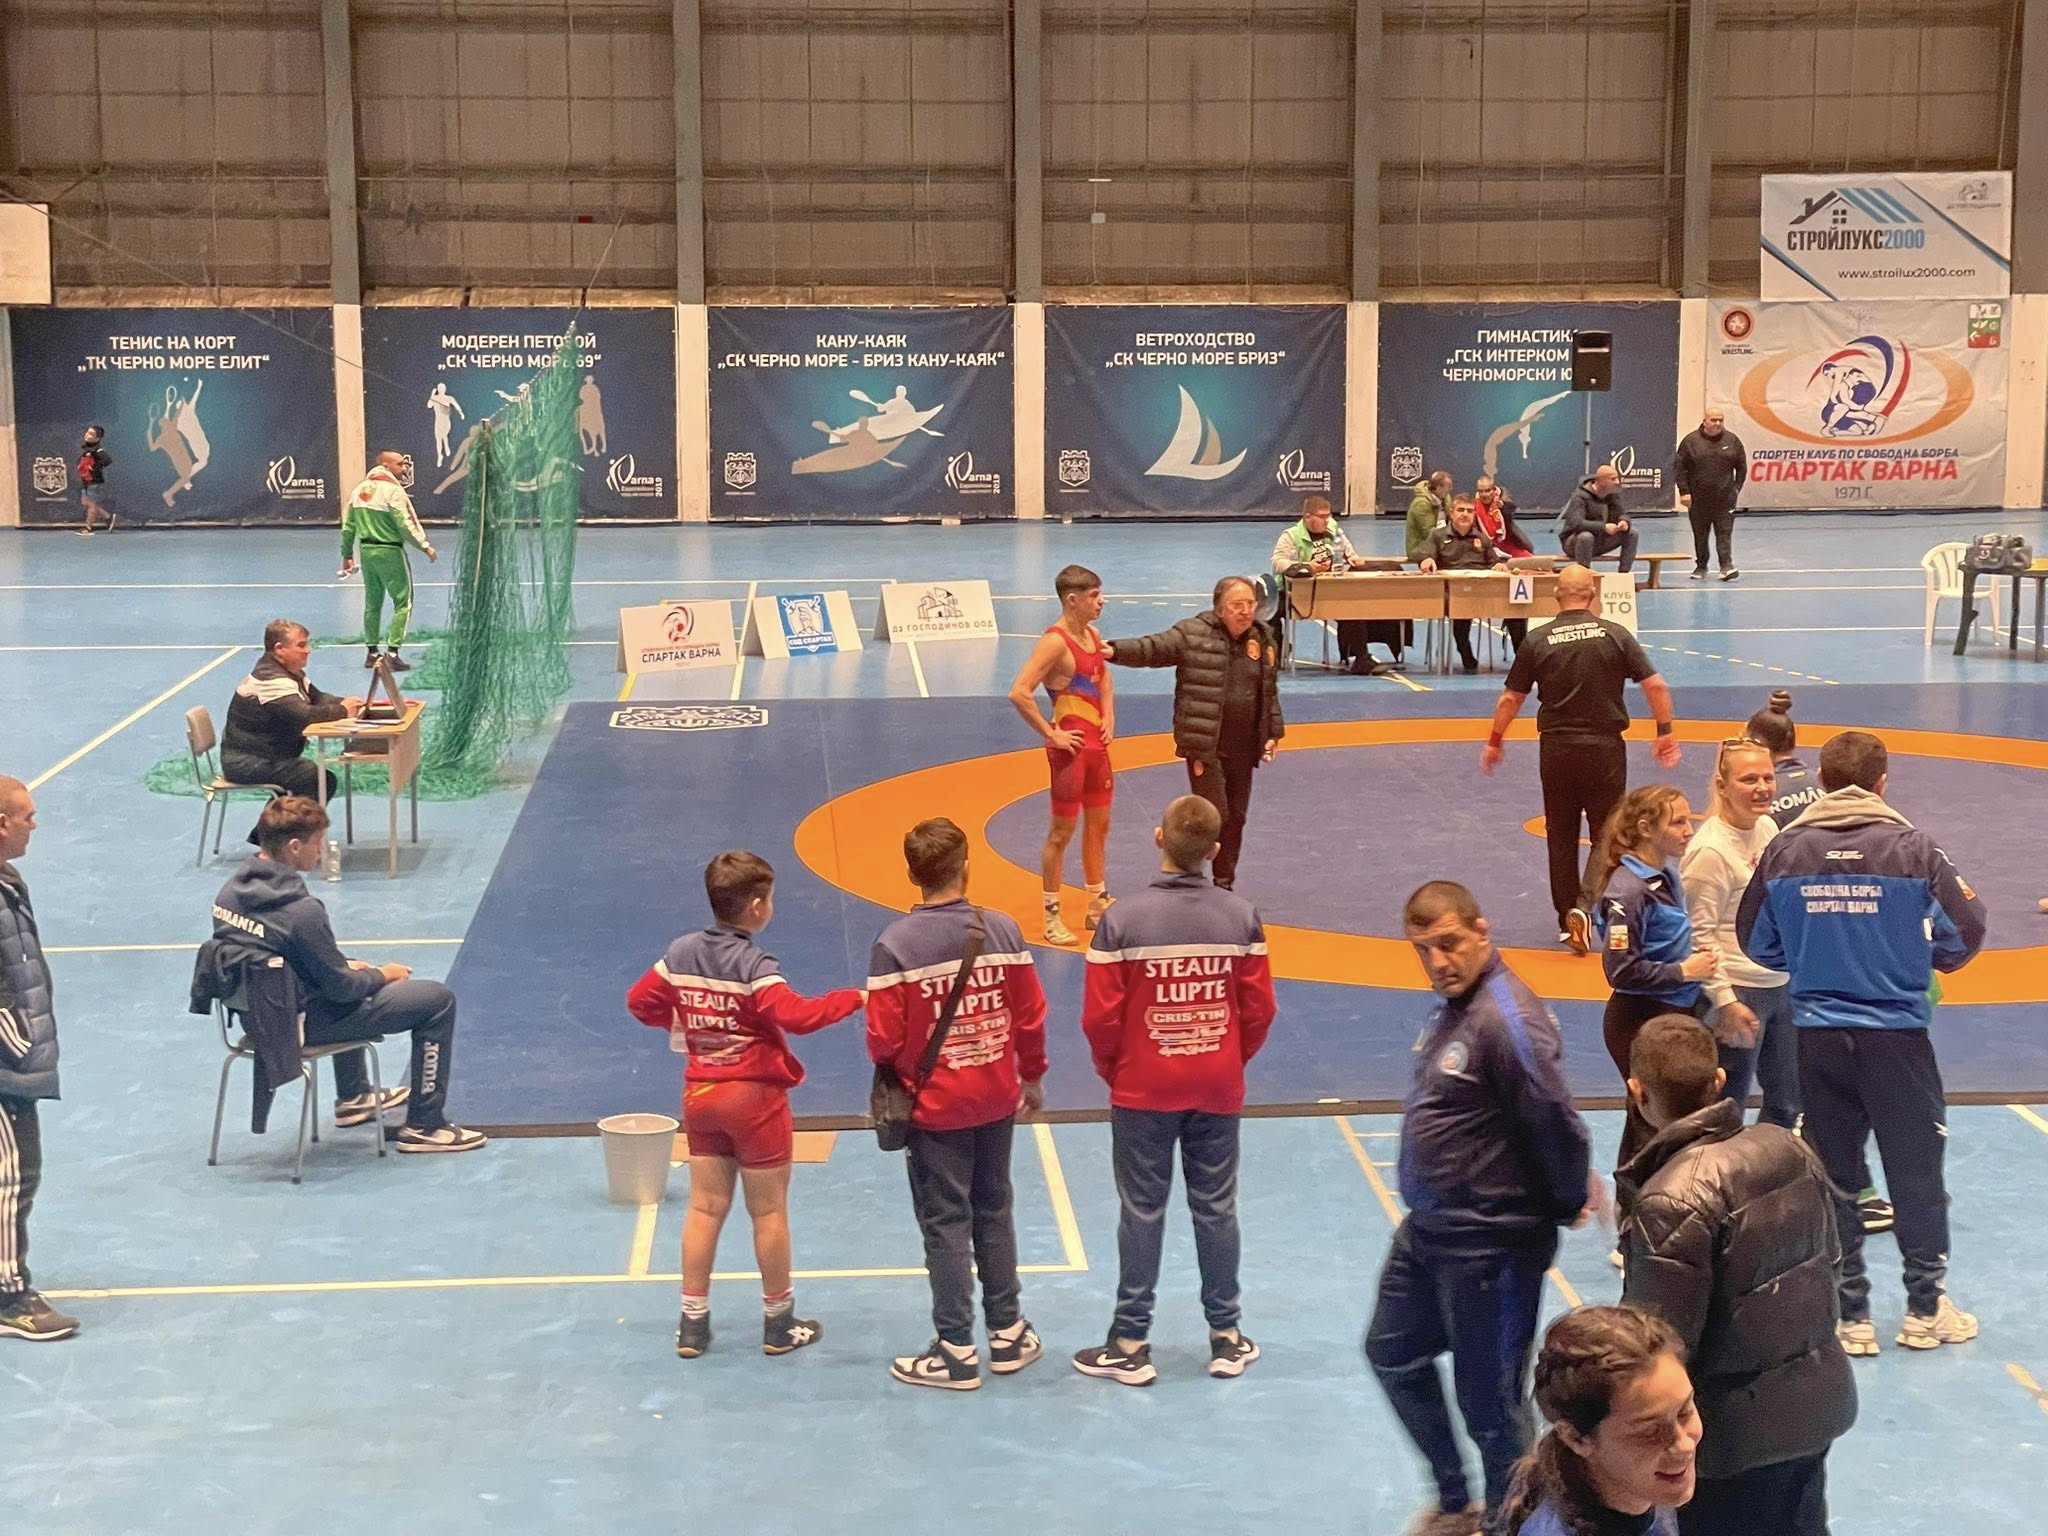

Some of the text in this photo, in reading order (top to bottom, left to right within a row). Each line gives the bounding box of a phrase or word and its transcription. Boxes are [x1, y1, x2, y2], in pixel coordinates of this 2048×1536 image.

[1787, 226, 1925, 250] СТРОЙЛУКС2000
[1838, 267, 1976, 279] www.stroilux2000.com
[109, 336, 236, 350] ТЕНИС НА КОРТ
[442, 332, 597, 350] МОДЕРЕН ПЕТООЙ
[816, 334, 907, 348] КАНУ-КАЯК
[1135, 332, 1256, 348] ВЕТРОХОДСТВО
[1477, 330, 1574, 344] ГИМНАСТИК
[470, 354, 523, 368] ЧЕРНО
[749, 354, 801, 368] ЧЕРНО
[804, 353, 848, 367] МОРЕ
[863, 353, 904, 367] БРИЗ
[1136, 352, 1188, 366] ЧЕРНО
[1191, 352, 1235, 365] МОРЕ
[1486, 348, 1569, 362] ИНТЕРКОМ
[110, 356, 165, 370] ЧЕРНО
[169, 356, 215, 370] МОРЕ
[1443, 368, 1557, 382] ЧЕРНОМОРСКИ
[1752, 448, 1959, 460] СПОРТЕН КЛУБ ПО СВОБОДНА БОРБА
[1750, 459, 1959, 483] СПАРТАК ВАРНА
[1834, 486, 1862, 499] 1971
[1603, 591, 1632, 600] КЛУБ
[906, 621, 971, 632] ГОСПОДИНОВ
[973, 620, 994, 628] ООД
[1547, 628, 1607, 645] WRESTLING
[642, 650, 687, 663] СПАРТАК
[688, 647, 721, 660] ВАРНА
[1768, 786, 1827, 814] ROMÂN
[1145, 956, 1233, 978] STEAUA
[1156, 979, 1226, 1003] LUPTE
[679, 989, 740, 1011] STEAUA
